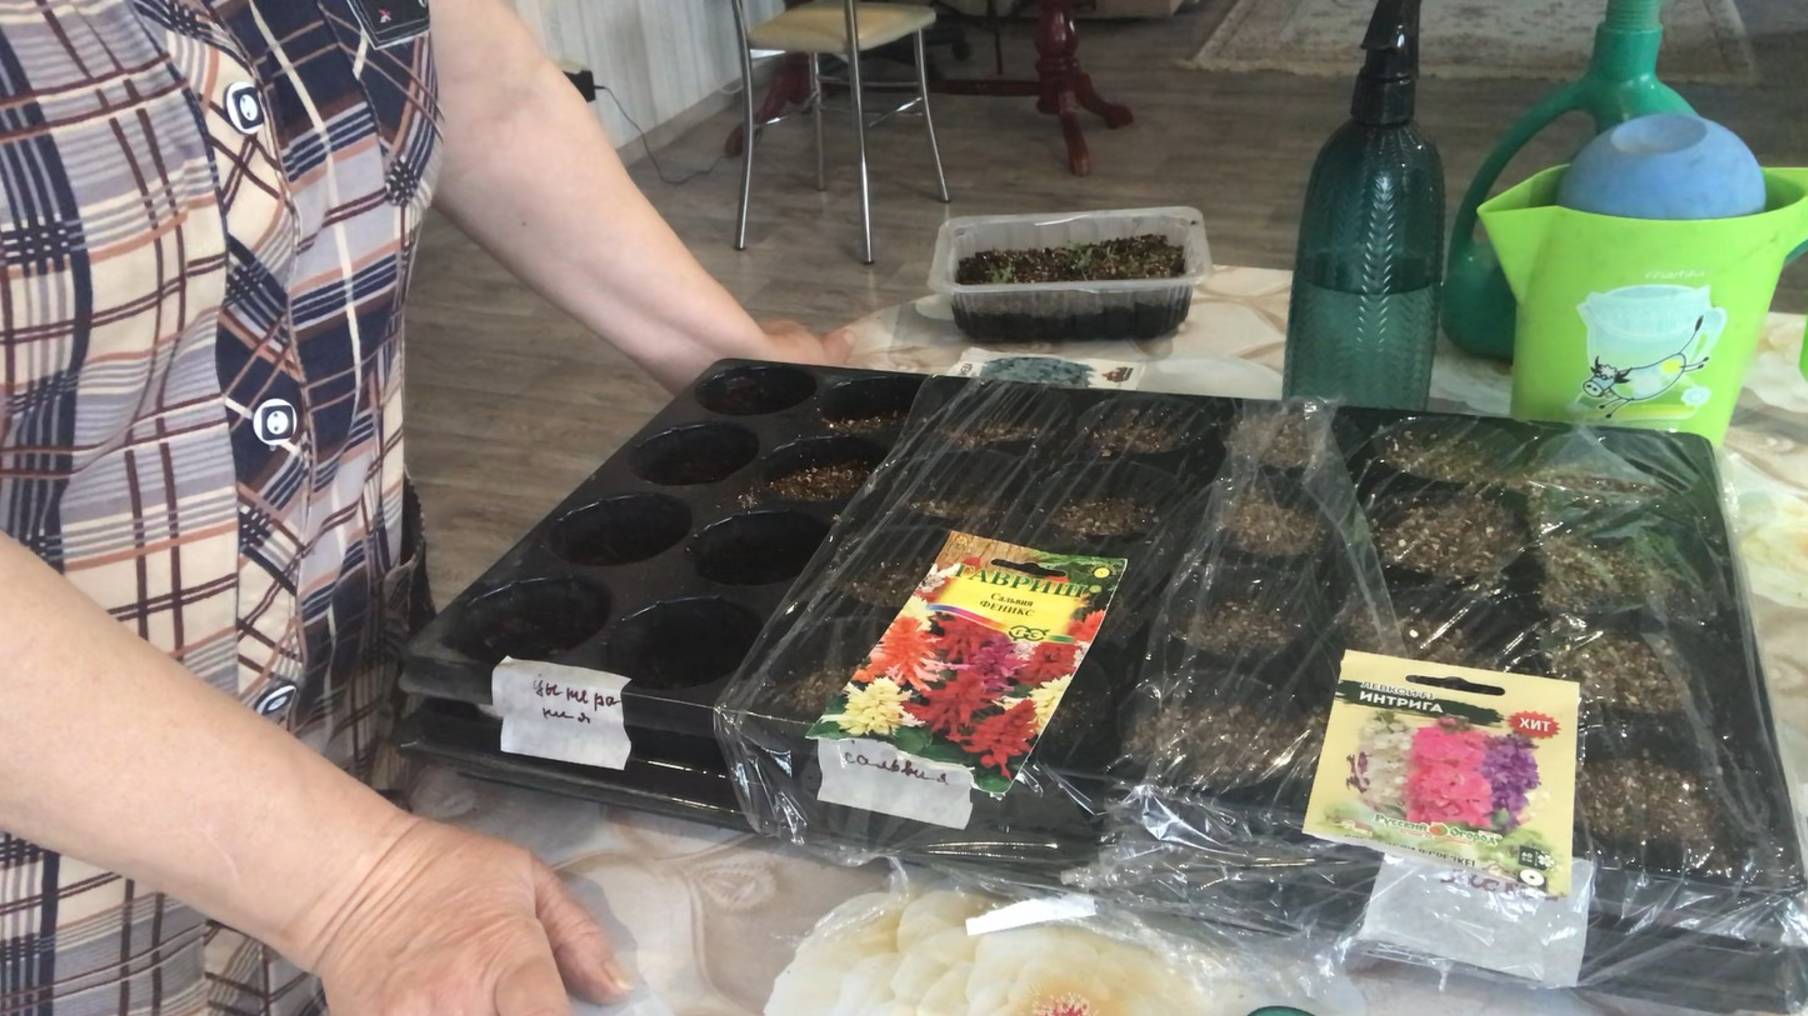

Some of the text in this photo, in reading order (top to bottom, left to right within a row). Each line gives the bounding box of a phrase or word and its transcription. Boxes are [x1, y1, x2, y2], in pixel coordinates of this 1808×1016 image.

[954, 563, 1088, 598] ГАВРИШ
[979, 600, 1035, 618] ФЕНИКС
[990, 592, 1034, 608] Сальвия
[1359, 690, 1444, 714] ИНТРИГА
[1519, 716, 1551, 732] ХИТ
[1375, 813, 1428, 832] Русский
